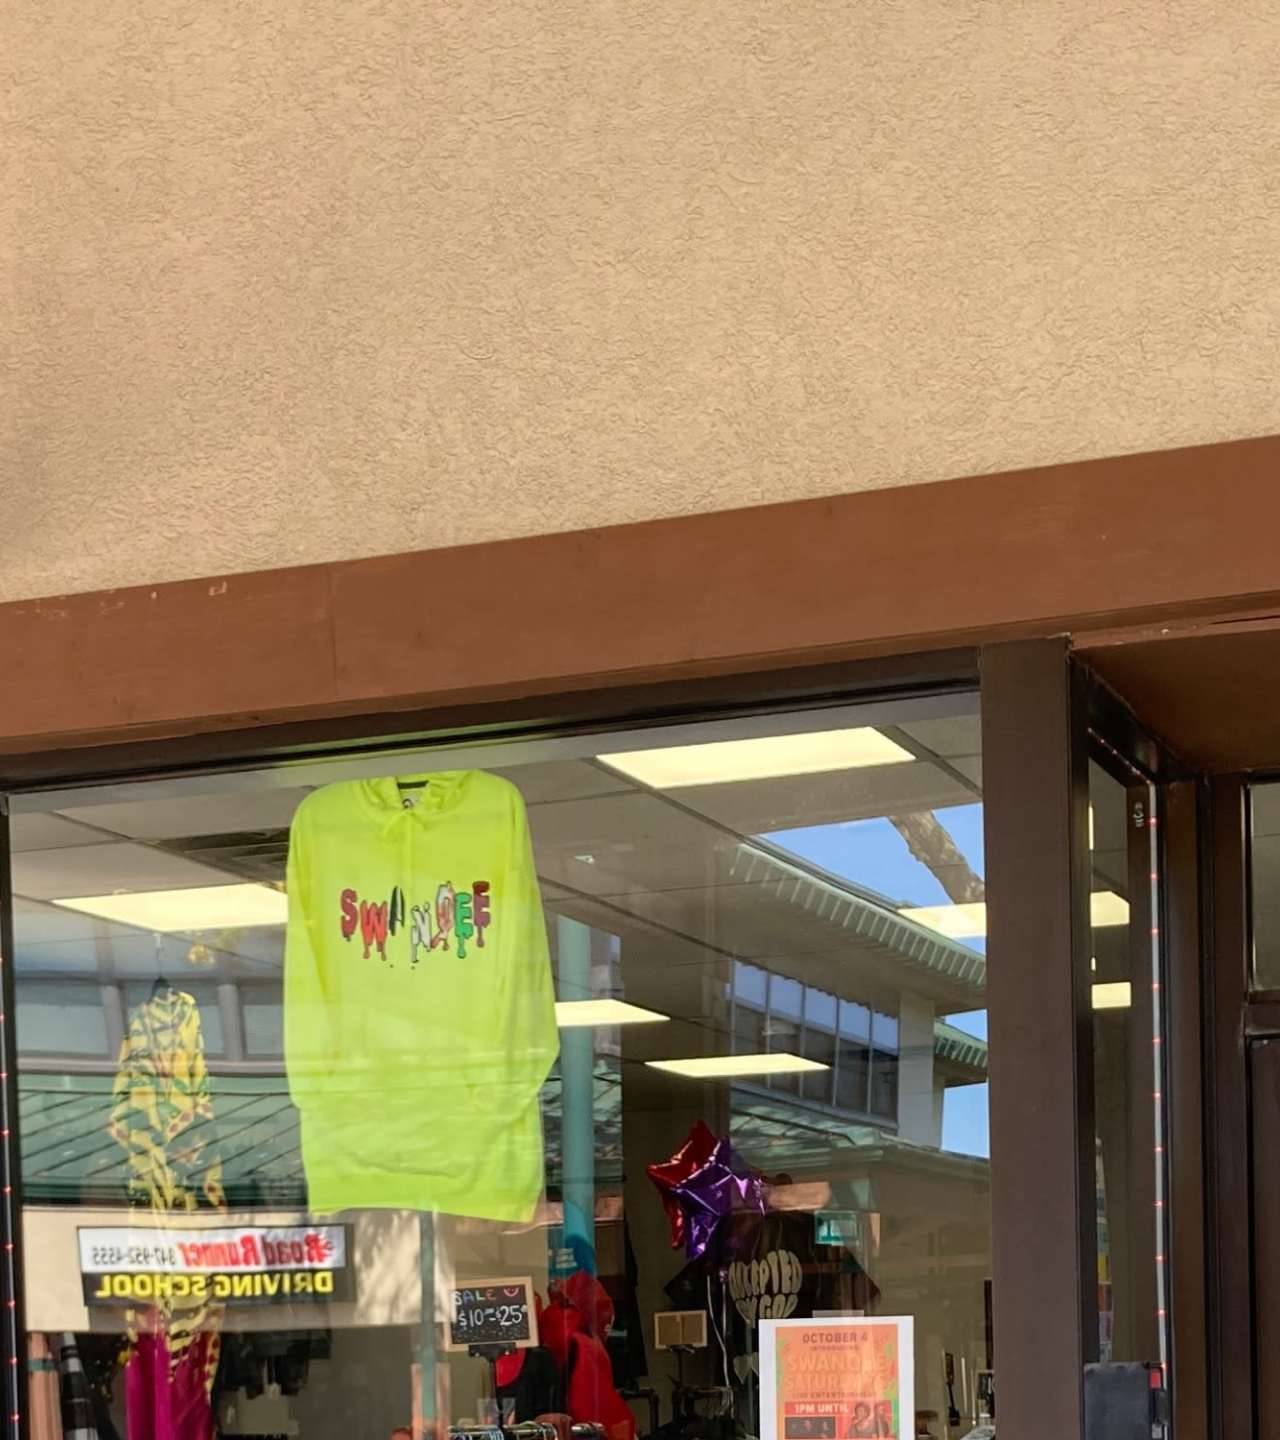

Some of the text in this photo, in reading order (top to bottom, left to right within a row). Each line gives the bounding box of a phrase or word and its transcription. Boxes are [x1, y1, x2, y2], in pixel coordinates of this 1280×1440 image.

[341, 881, 491, 962] SWANQEE
[452, 1288, 496, 1305] SALE
[802, 1332, 858, 1344] OCTOBER
[794, 1403, 848, 1413] 1PM UNTIL
